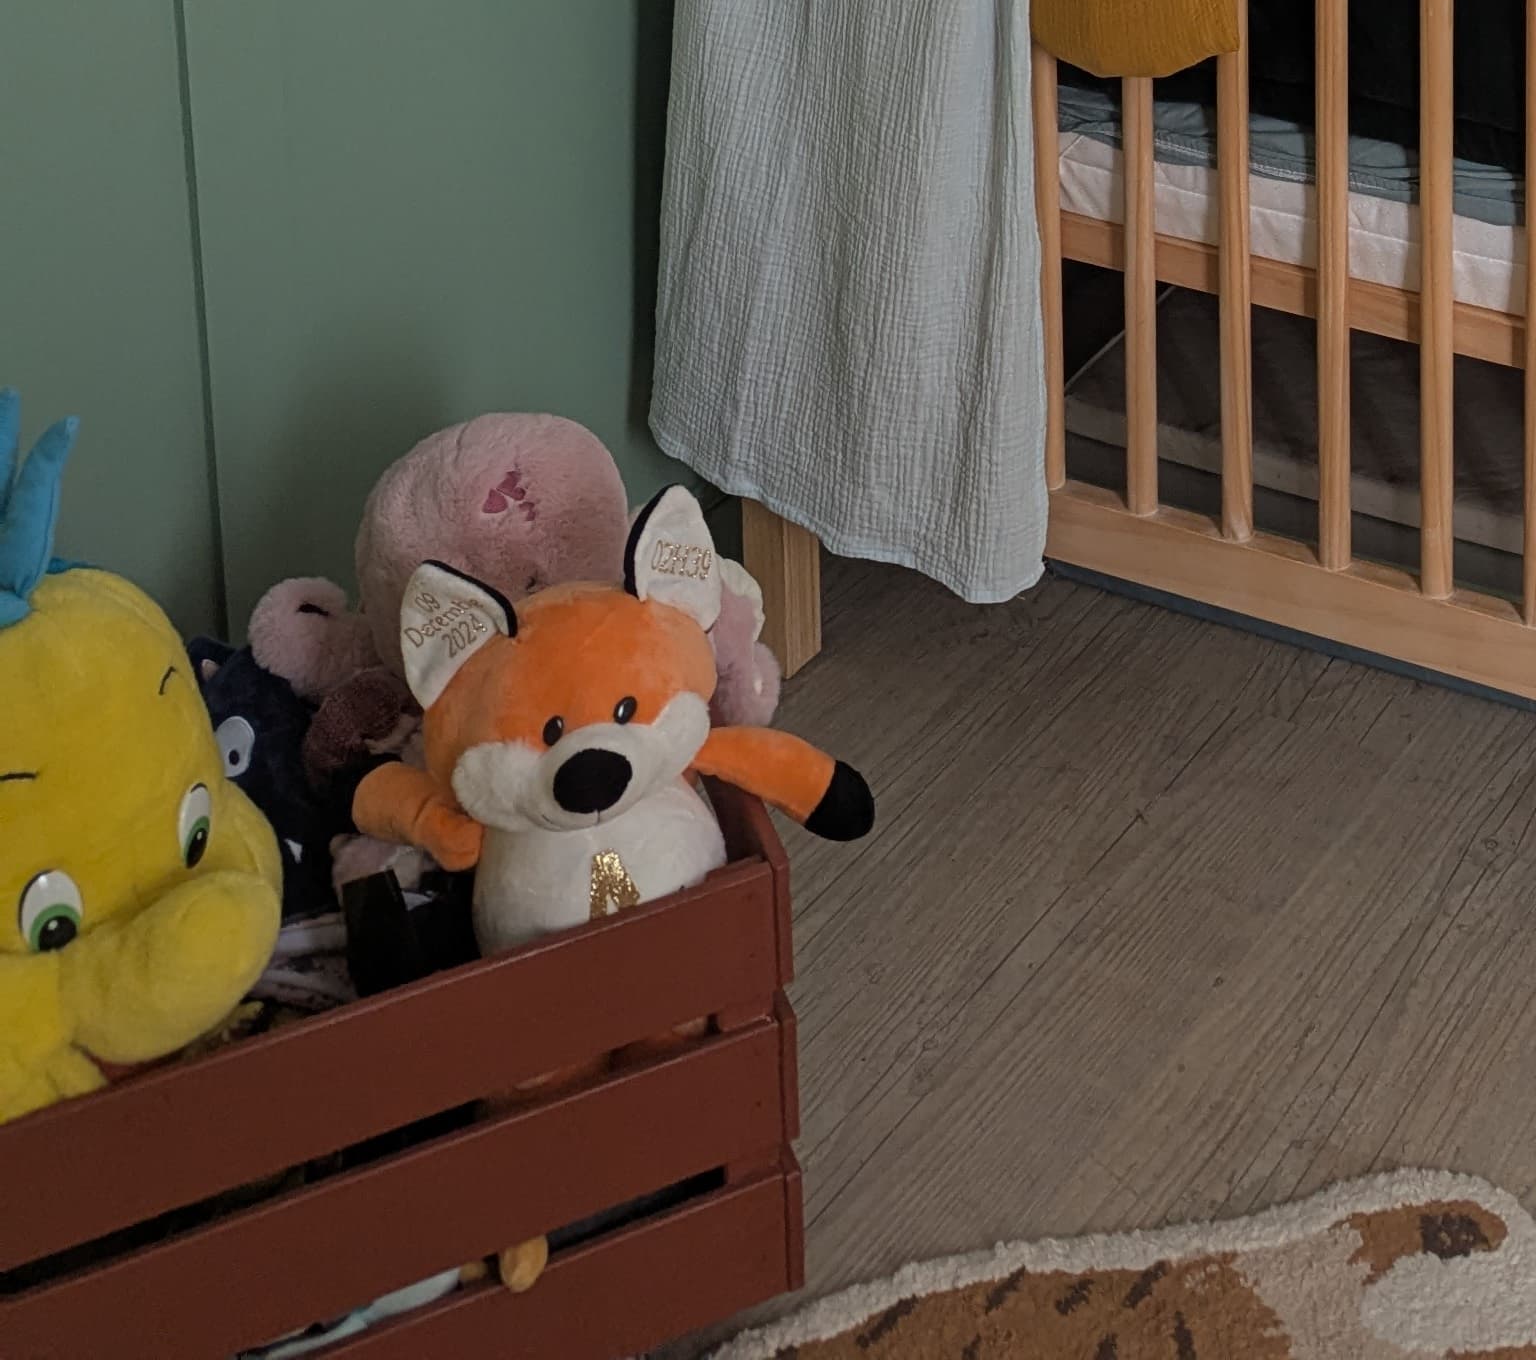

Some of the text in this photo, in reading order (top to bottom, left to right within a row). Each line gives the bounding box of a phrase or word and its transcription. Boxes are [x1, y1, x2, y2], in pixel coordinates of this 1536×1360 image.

[651, 539, 712, 580] 02H39
[404, 598, 484, 648] Decembe
[441, 613, 487, 659] 2024
